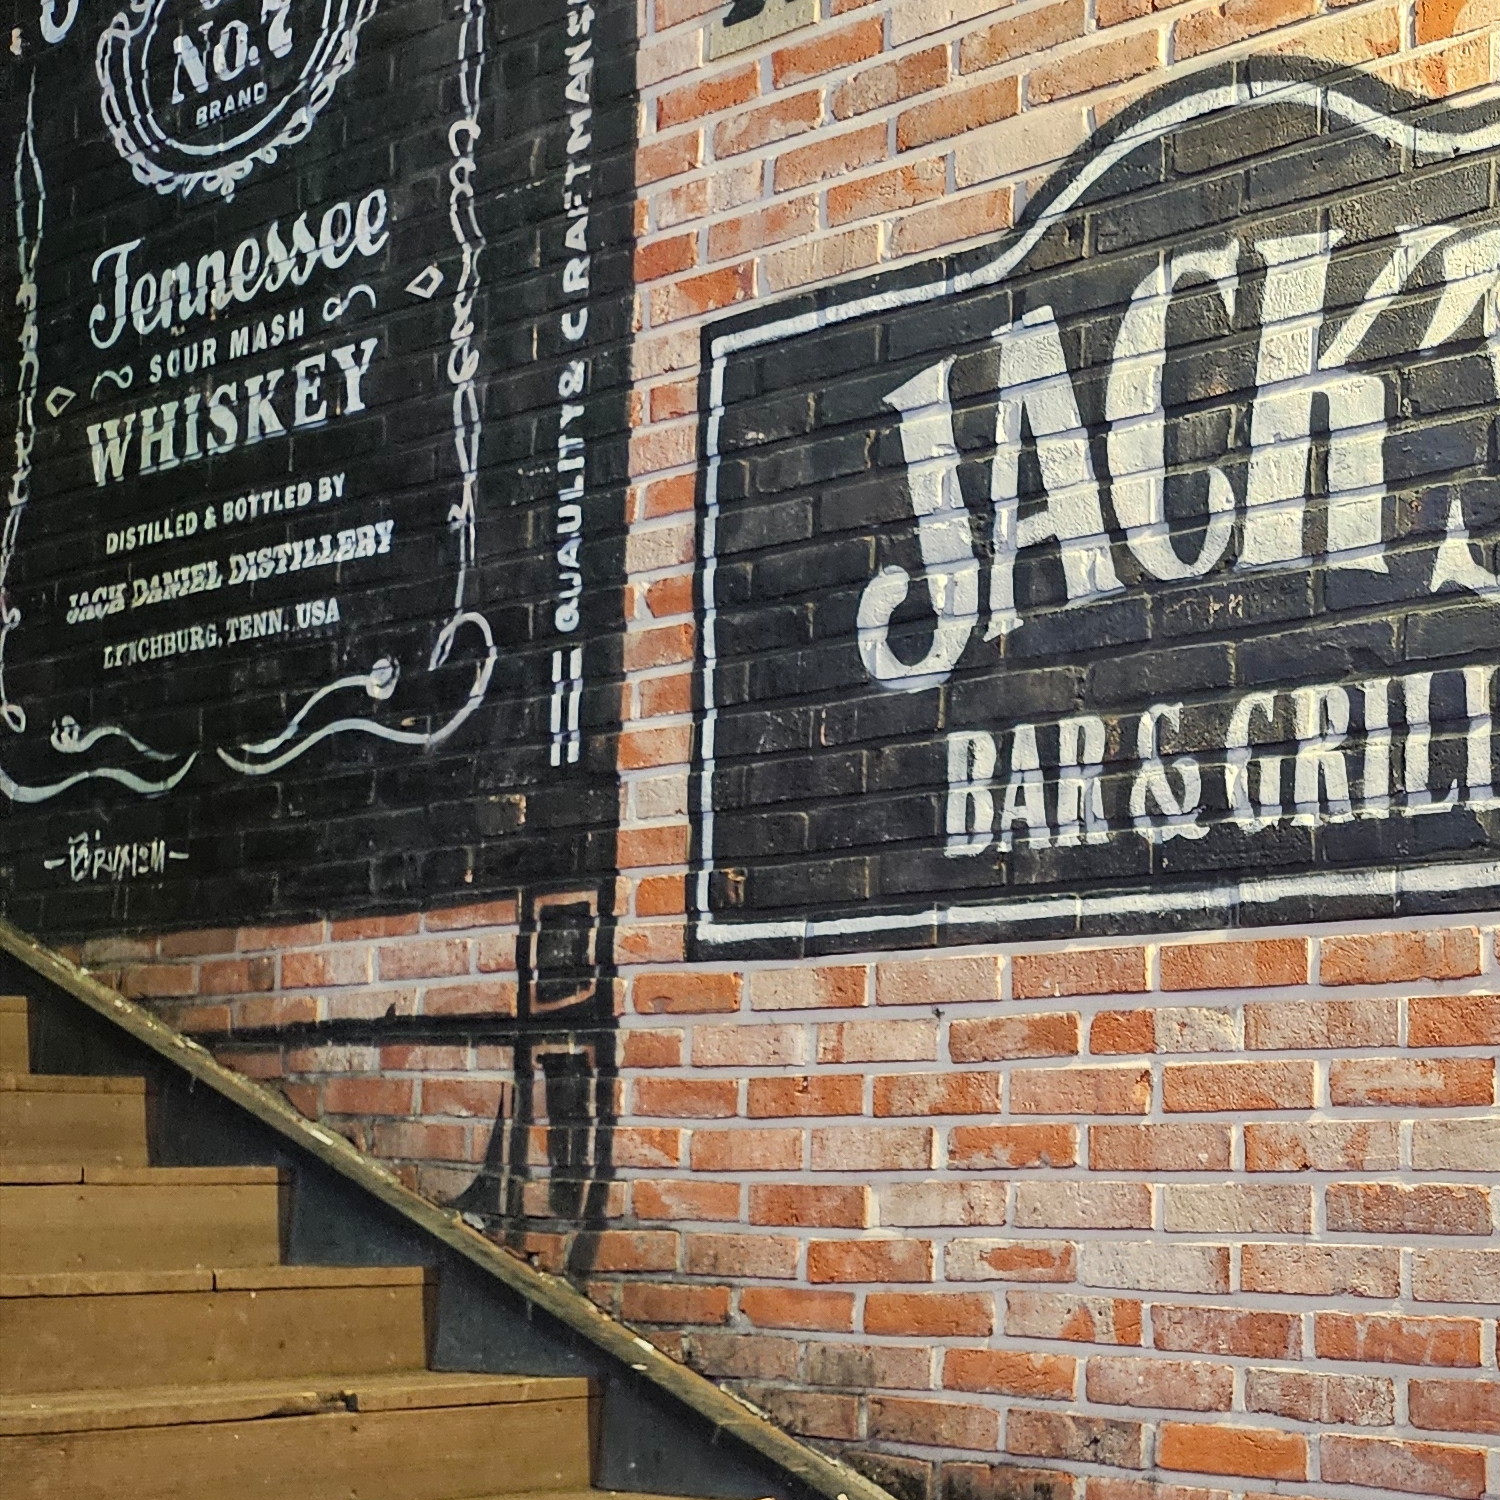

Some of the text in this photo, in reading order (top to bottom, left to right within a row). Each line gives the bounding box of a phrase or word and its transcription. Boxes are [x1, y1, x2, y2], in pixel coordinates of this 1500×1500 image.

[196, 81, 268, 127] BRAND
[89, 188, 390, 349] Tennessee
[149, 307, 305, 384] SOUR MASH
[87, 338, 379, 487] WHISKEY
[106, 472, 346, 555] DISTILLED & BOTTLED BY
[66, 519, 395, 626] JACK DANIEL DISTILLERY
[295, 598, 341, 629] USA
[944, 715, 1110, 858] BAR
[1129, 702, 1210, 844] &
